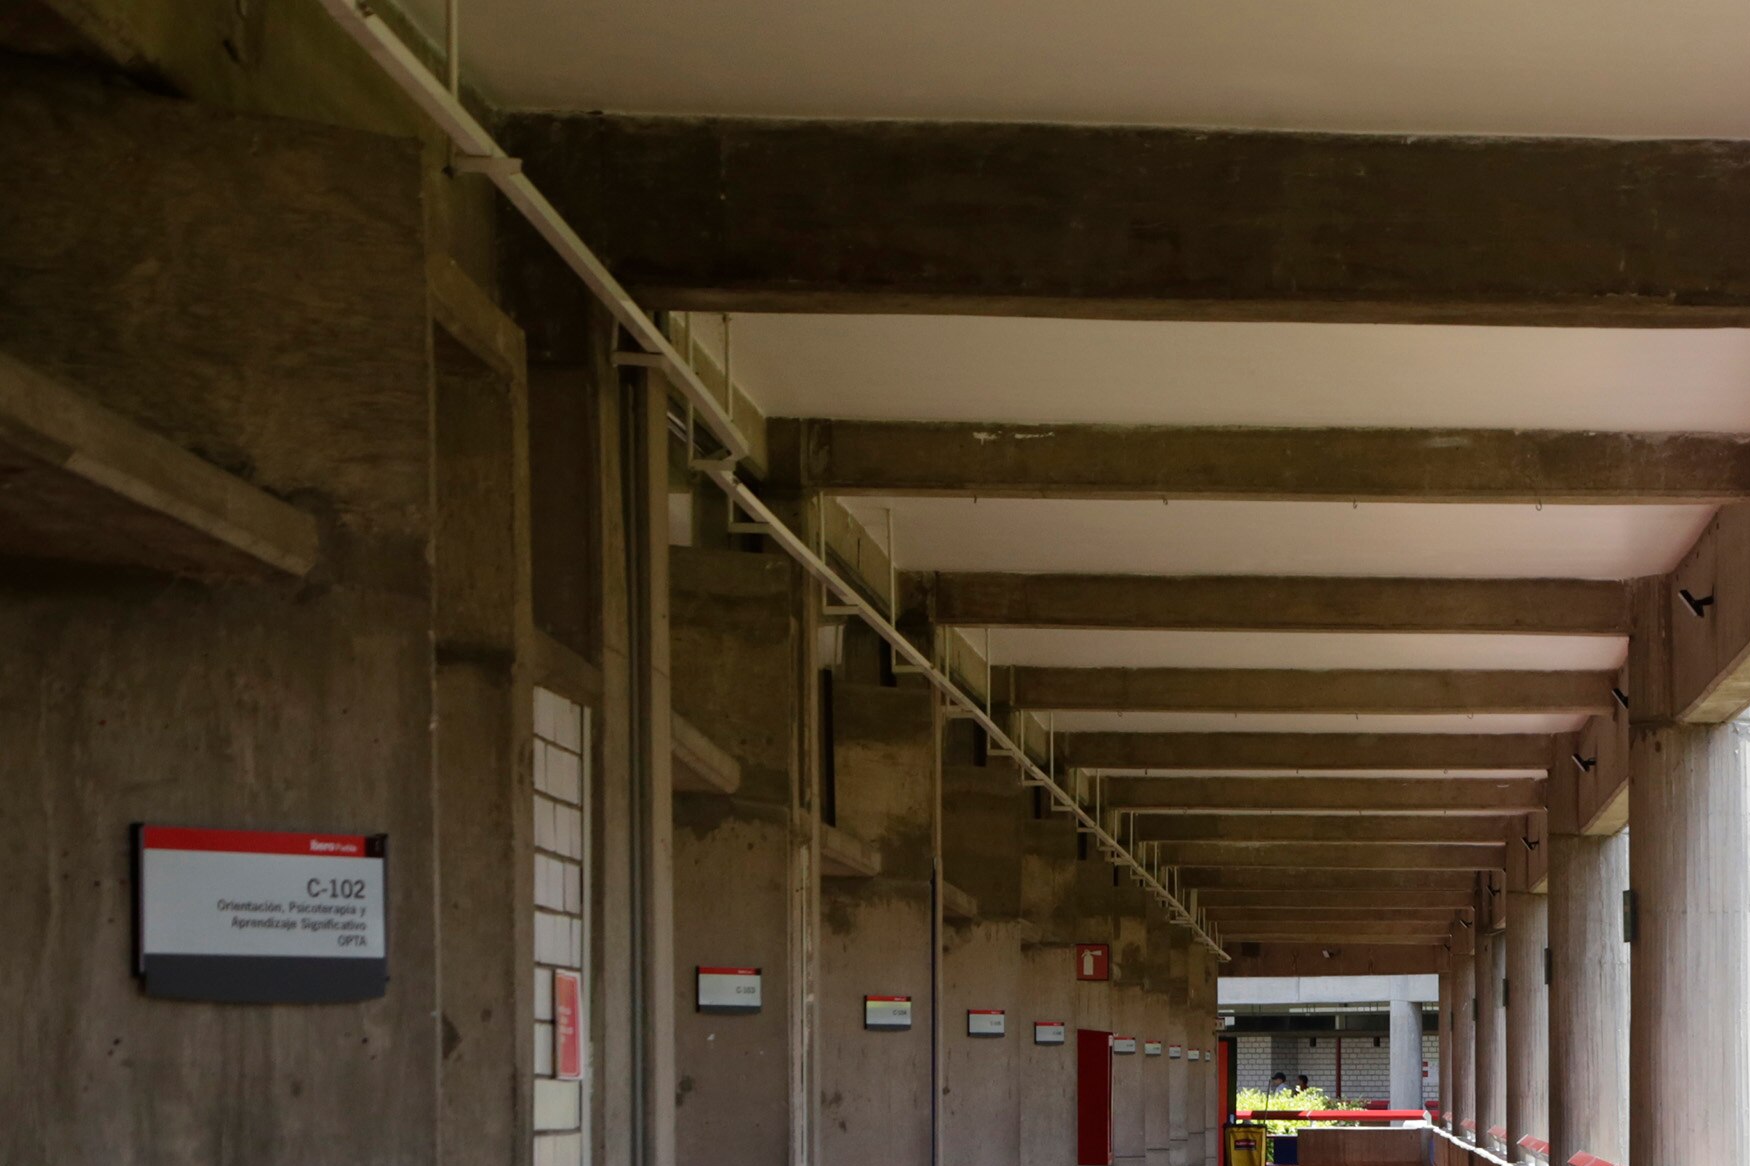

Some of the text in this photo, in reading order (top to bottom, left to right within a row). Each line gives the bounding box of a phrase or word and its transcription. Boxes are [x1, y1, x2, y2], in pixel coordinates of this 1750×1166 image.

[307, 878, 366, 899] C-102
[217, 900, 366, 917] Orientación, Psicoterapia y
[231, 917, 367, 932] Aprendizaje Significativo
